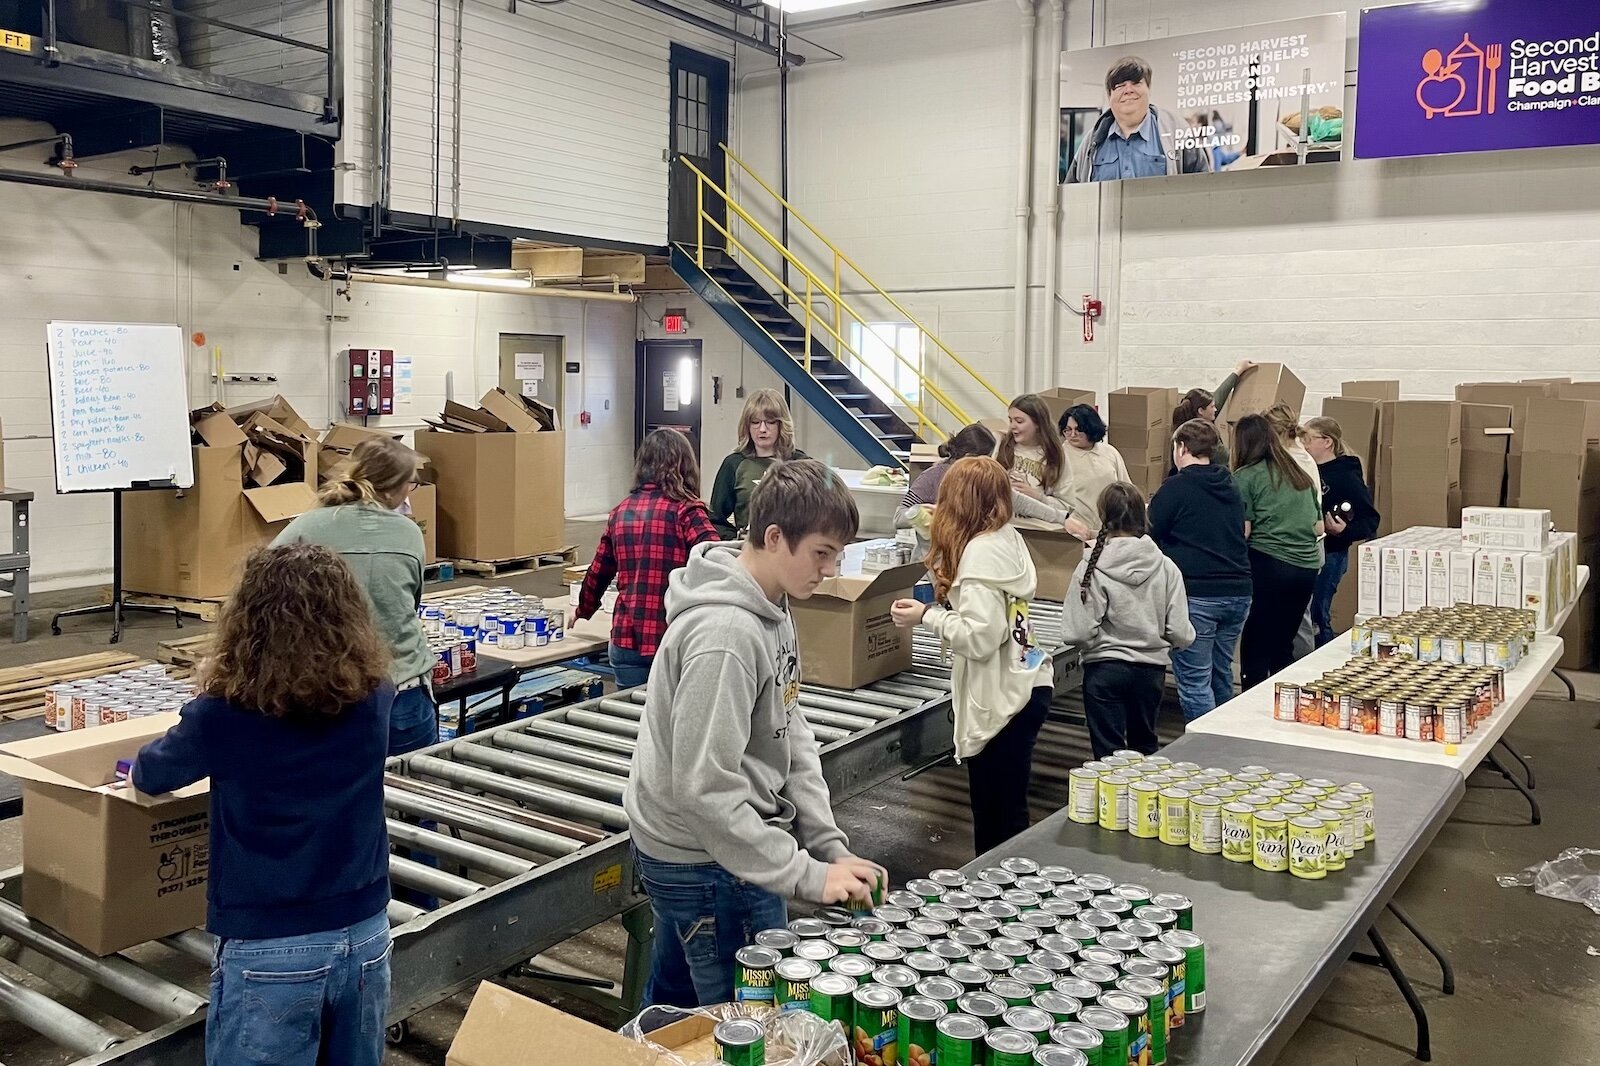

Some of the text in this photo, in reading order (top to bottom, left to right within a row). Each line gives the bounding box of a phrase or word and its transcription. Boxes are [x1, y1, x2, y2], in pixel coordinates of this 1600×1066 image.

[5, 33, 23, 47] FT.
[1240, 34, 1307, 53] HARVEST
[1509, 31, 1600, 59] Second
[1178, 47, 1310, 73] FOOD BANK HELPS
[1510, 53, 1599, 78] Harvest
[1177, 63, 1280, 85] MY WIFE AND I
[1177, 76, 1276, 97] SUPPORT OUR
[1508, 73, 1576, 98] Food
[1176, 90, 1252, 109] HOMELESS
[1507, 98, 1572, 112] Champaign
[1175, 126, 1216, 139] DAVID
[1174, 134, 1241, 150] HOLLAND
[665, 316, 682, 332] EXIT
[56, 329, 64, 338] 2
[72, 328, 108, 337] Peaches
[57, 341, 64, 349] 1
[71, 339, 93, 347] Pear
[72, 349, 97, 358] Juice
[58, 361, 64, 369] 4
[72, 367, 100, 377] Sweet
[64, 454, 71, 462] 2
[66, 466, 72, 476] 1
[1291, 837, 1324, 855] Pears
